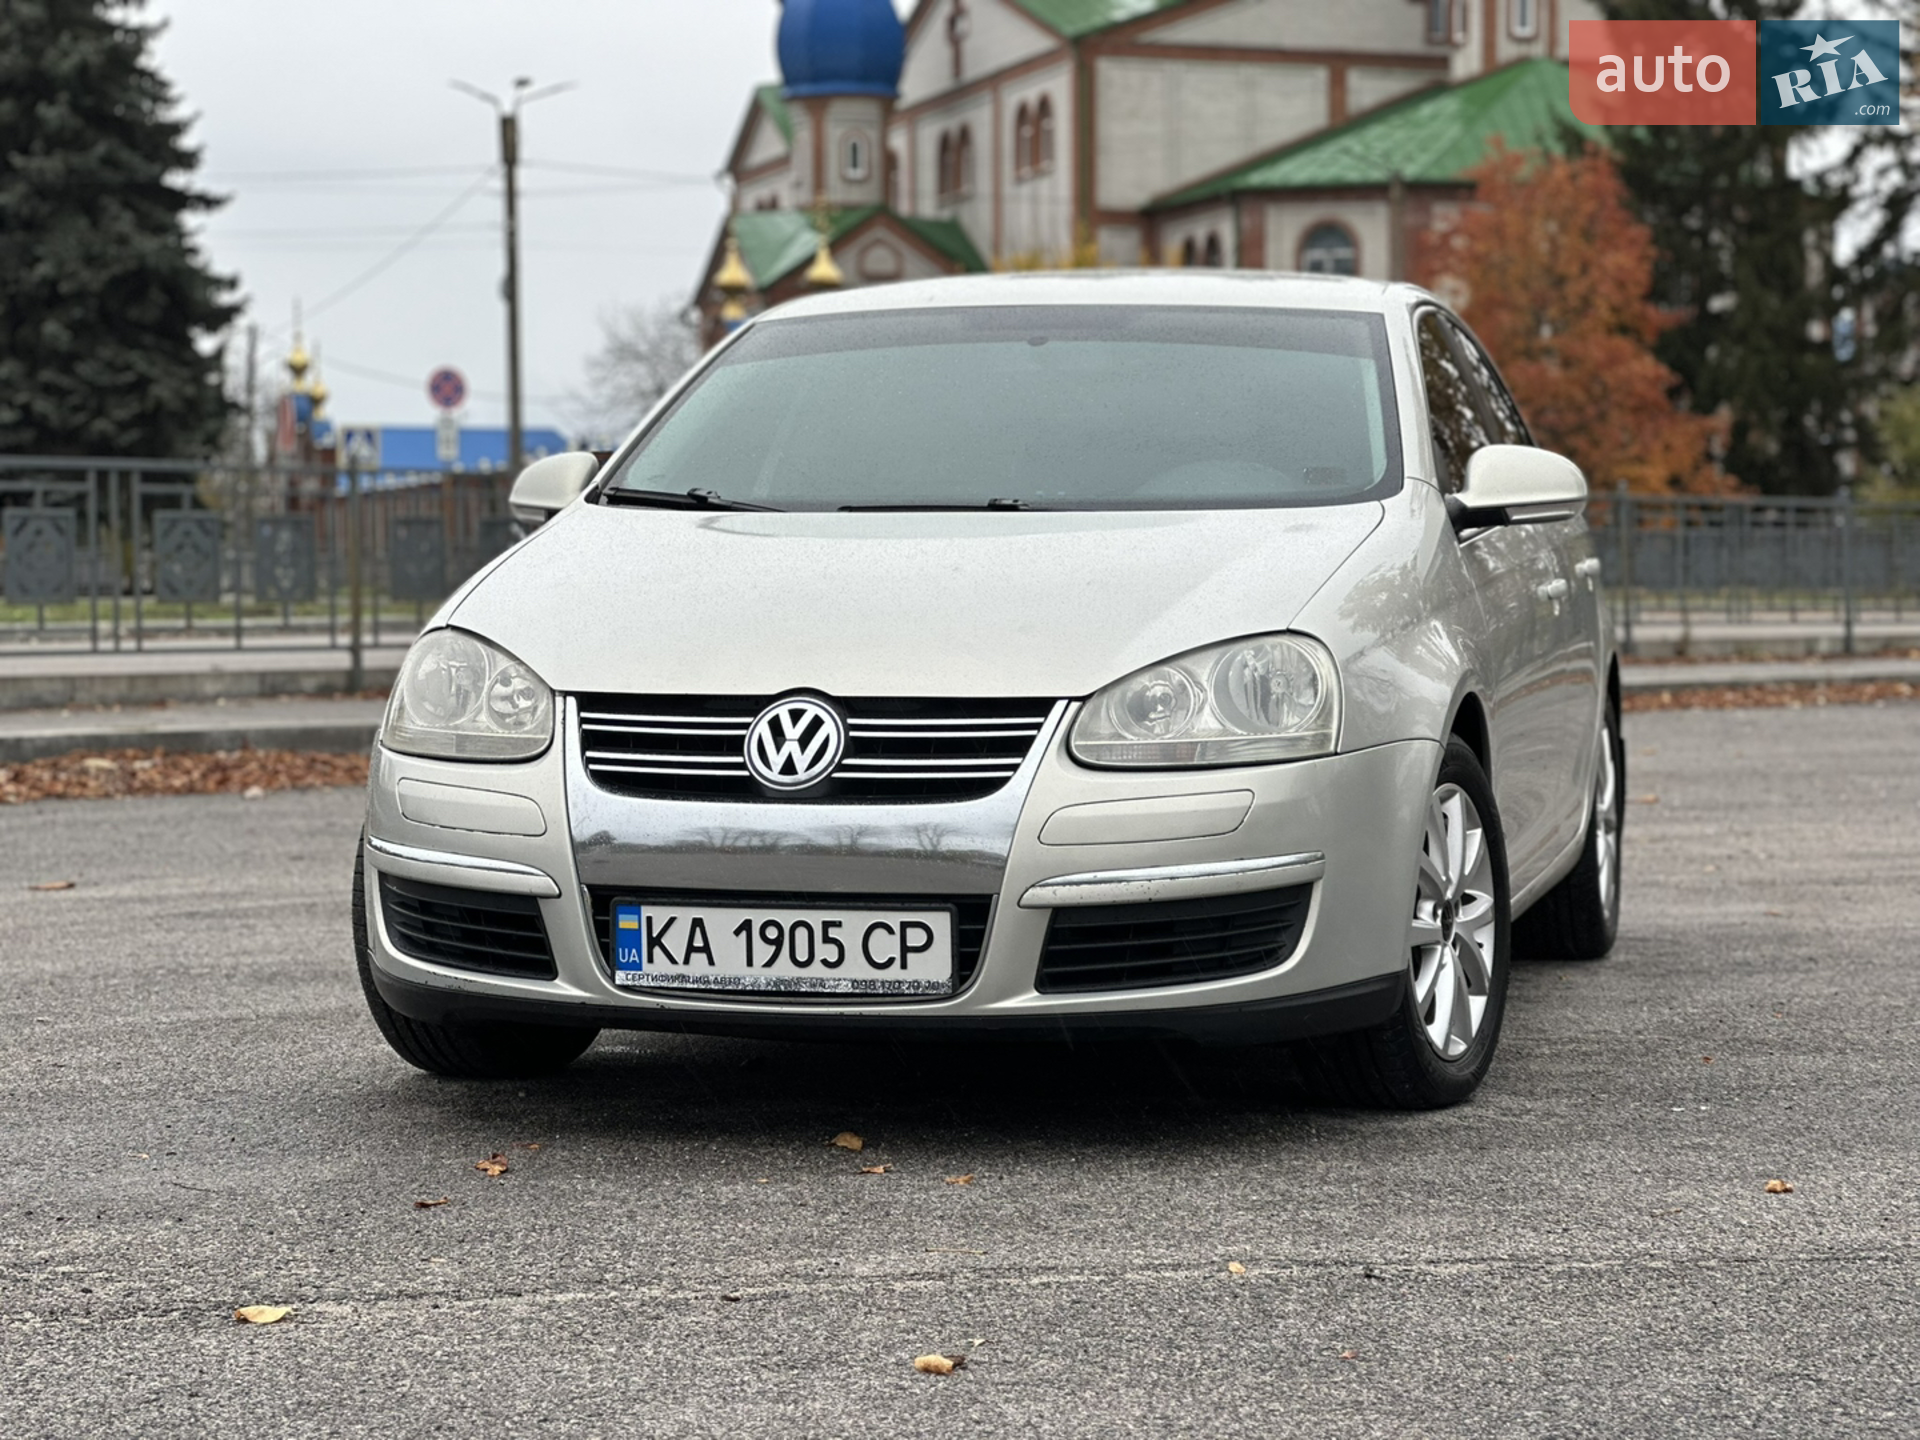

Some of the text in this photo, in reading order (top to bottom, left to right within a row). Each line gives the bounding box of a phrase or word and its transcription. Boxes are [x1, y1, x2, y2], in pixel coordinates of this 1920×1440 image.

[755, 705, 832, 778] VW
[618, 947, 640, 964] UA
[645, 915, 934, 970] KA 1905 CP
